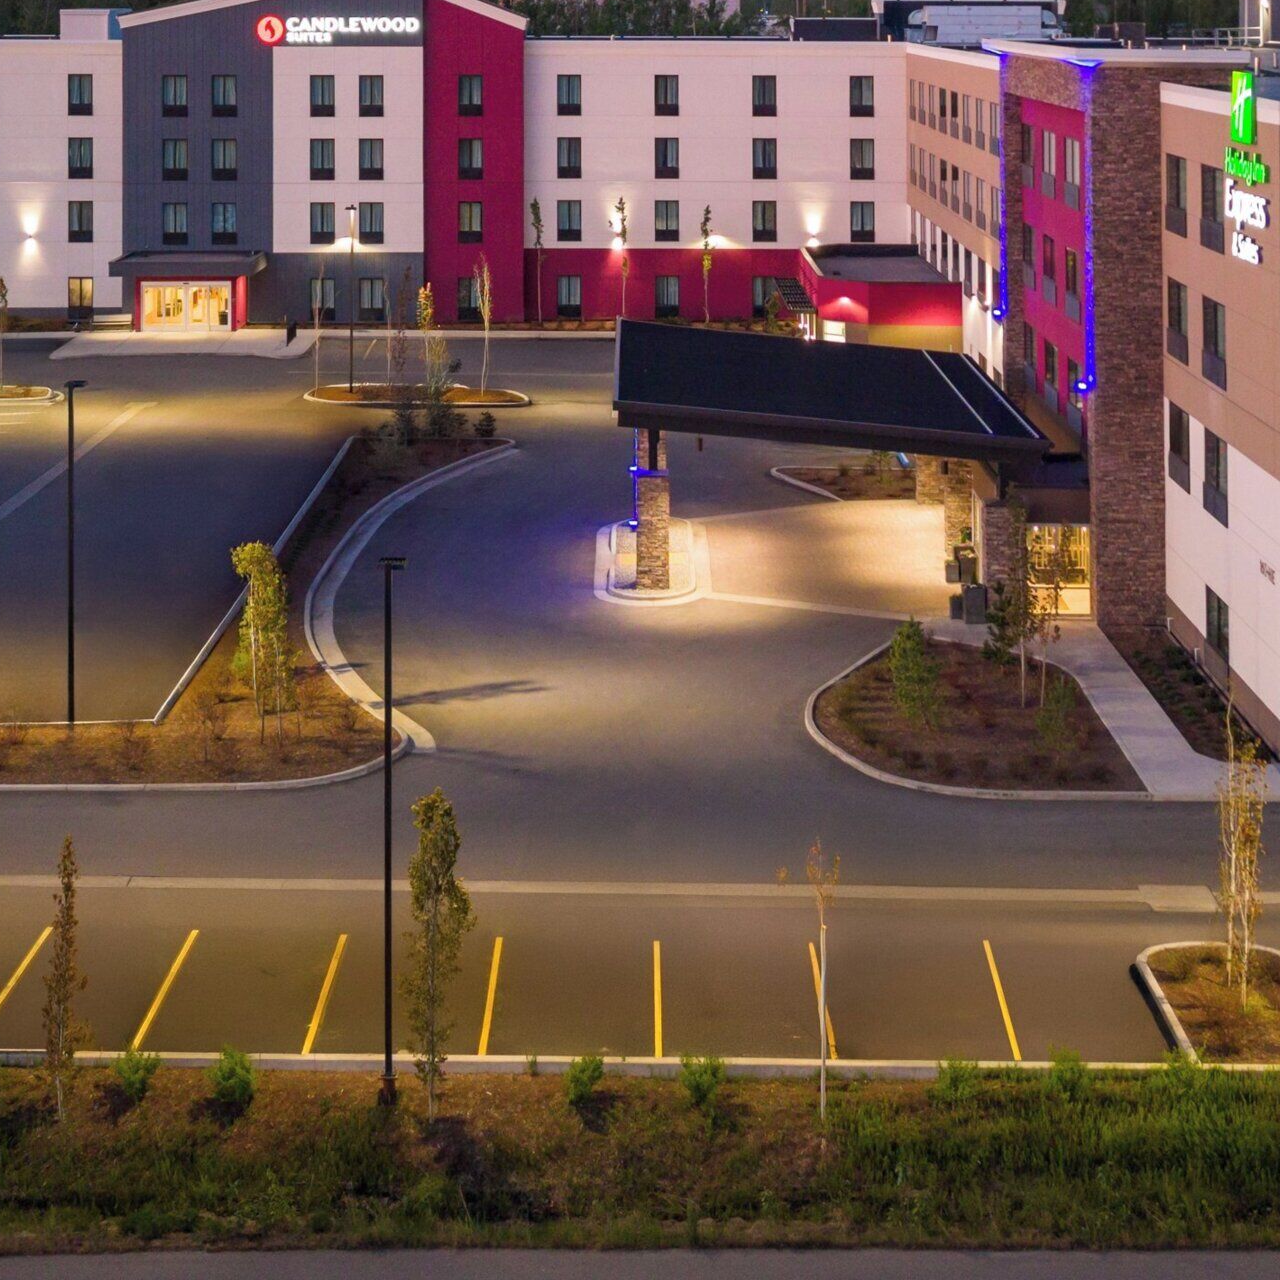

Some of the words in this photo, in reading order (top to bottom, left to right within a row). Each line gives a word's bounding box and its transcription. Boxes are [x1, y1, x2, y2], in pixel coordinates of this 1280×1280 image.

[285, 17, 420, 32] CANDLEWOOD
[286, 32, 332, 43] SUITES
[1225, 146, 1253, 187] Holiday
[1253, 153, 1266, 184] Inn
[1225, 178, 1266, 231] Express
